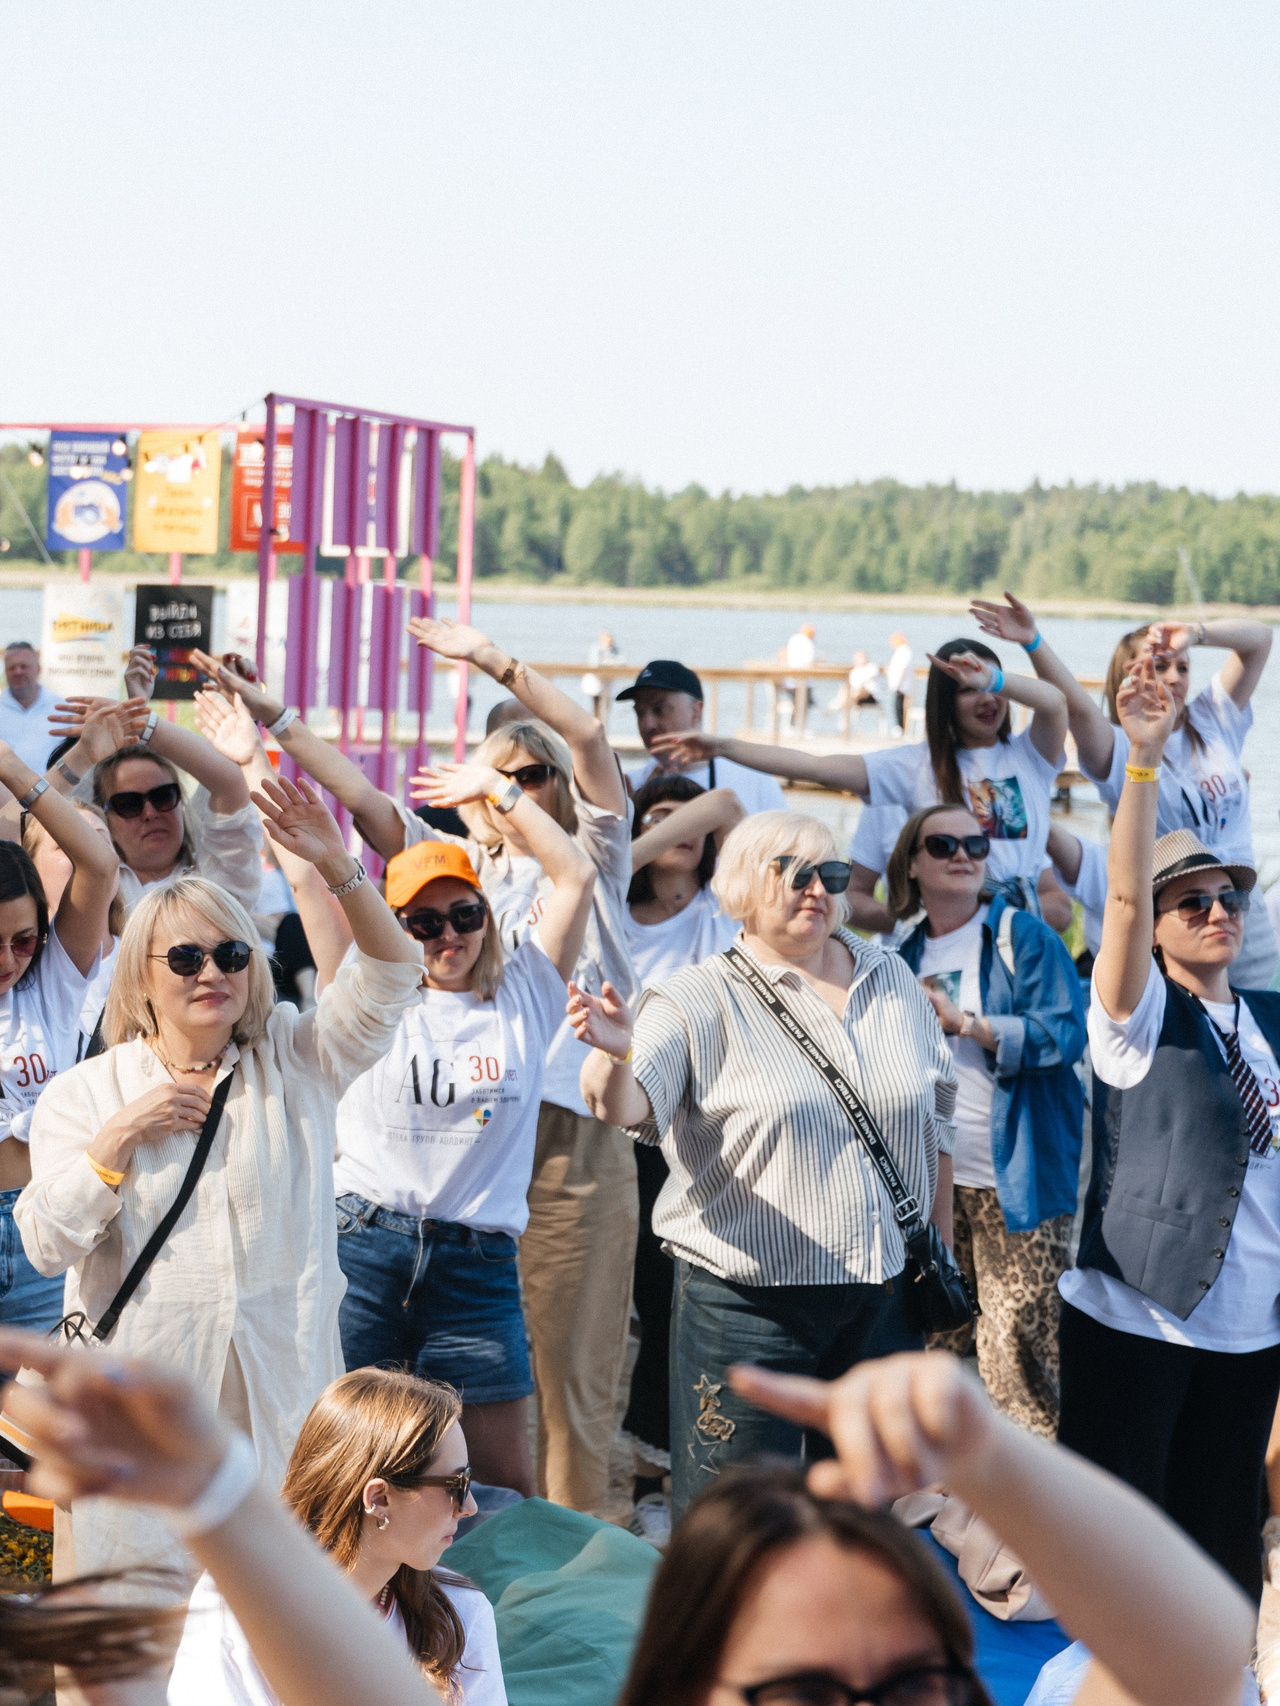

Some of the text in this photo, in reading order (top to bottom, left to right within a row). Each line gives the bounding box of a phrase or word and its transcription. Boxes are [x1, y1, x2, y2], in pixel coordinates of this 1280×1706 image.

[149, 600, 198, 622] ВЫЙДИ
[145, 621, 202, 640] ИЗ СЕБЯ
[1201, 774, 1226, 803] 30
[751, 975, 776, 1005] DANIELE
[780, 1011, 828, 1069] DANIELE PATRICI
[13, 1053, 47, 1087] 30
[395, 1054, 456, 1108] AG
[469, 1055, 500, 1082] 30
[1264, 1077, 1280, 1107] 3
[834, 1078, 877, 1146] DANIELE PATRICI
[412, 1135, 435, 1144] ГРУПП
[439, 1136, 474, 1146] ХОЛДИНГ
[879, 1156, 898, 1188] PATRICI
